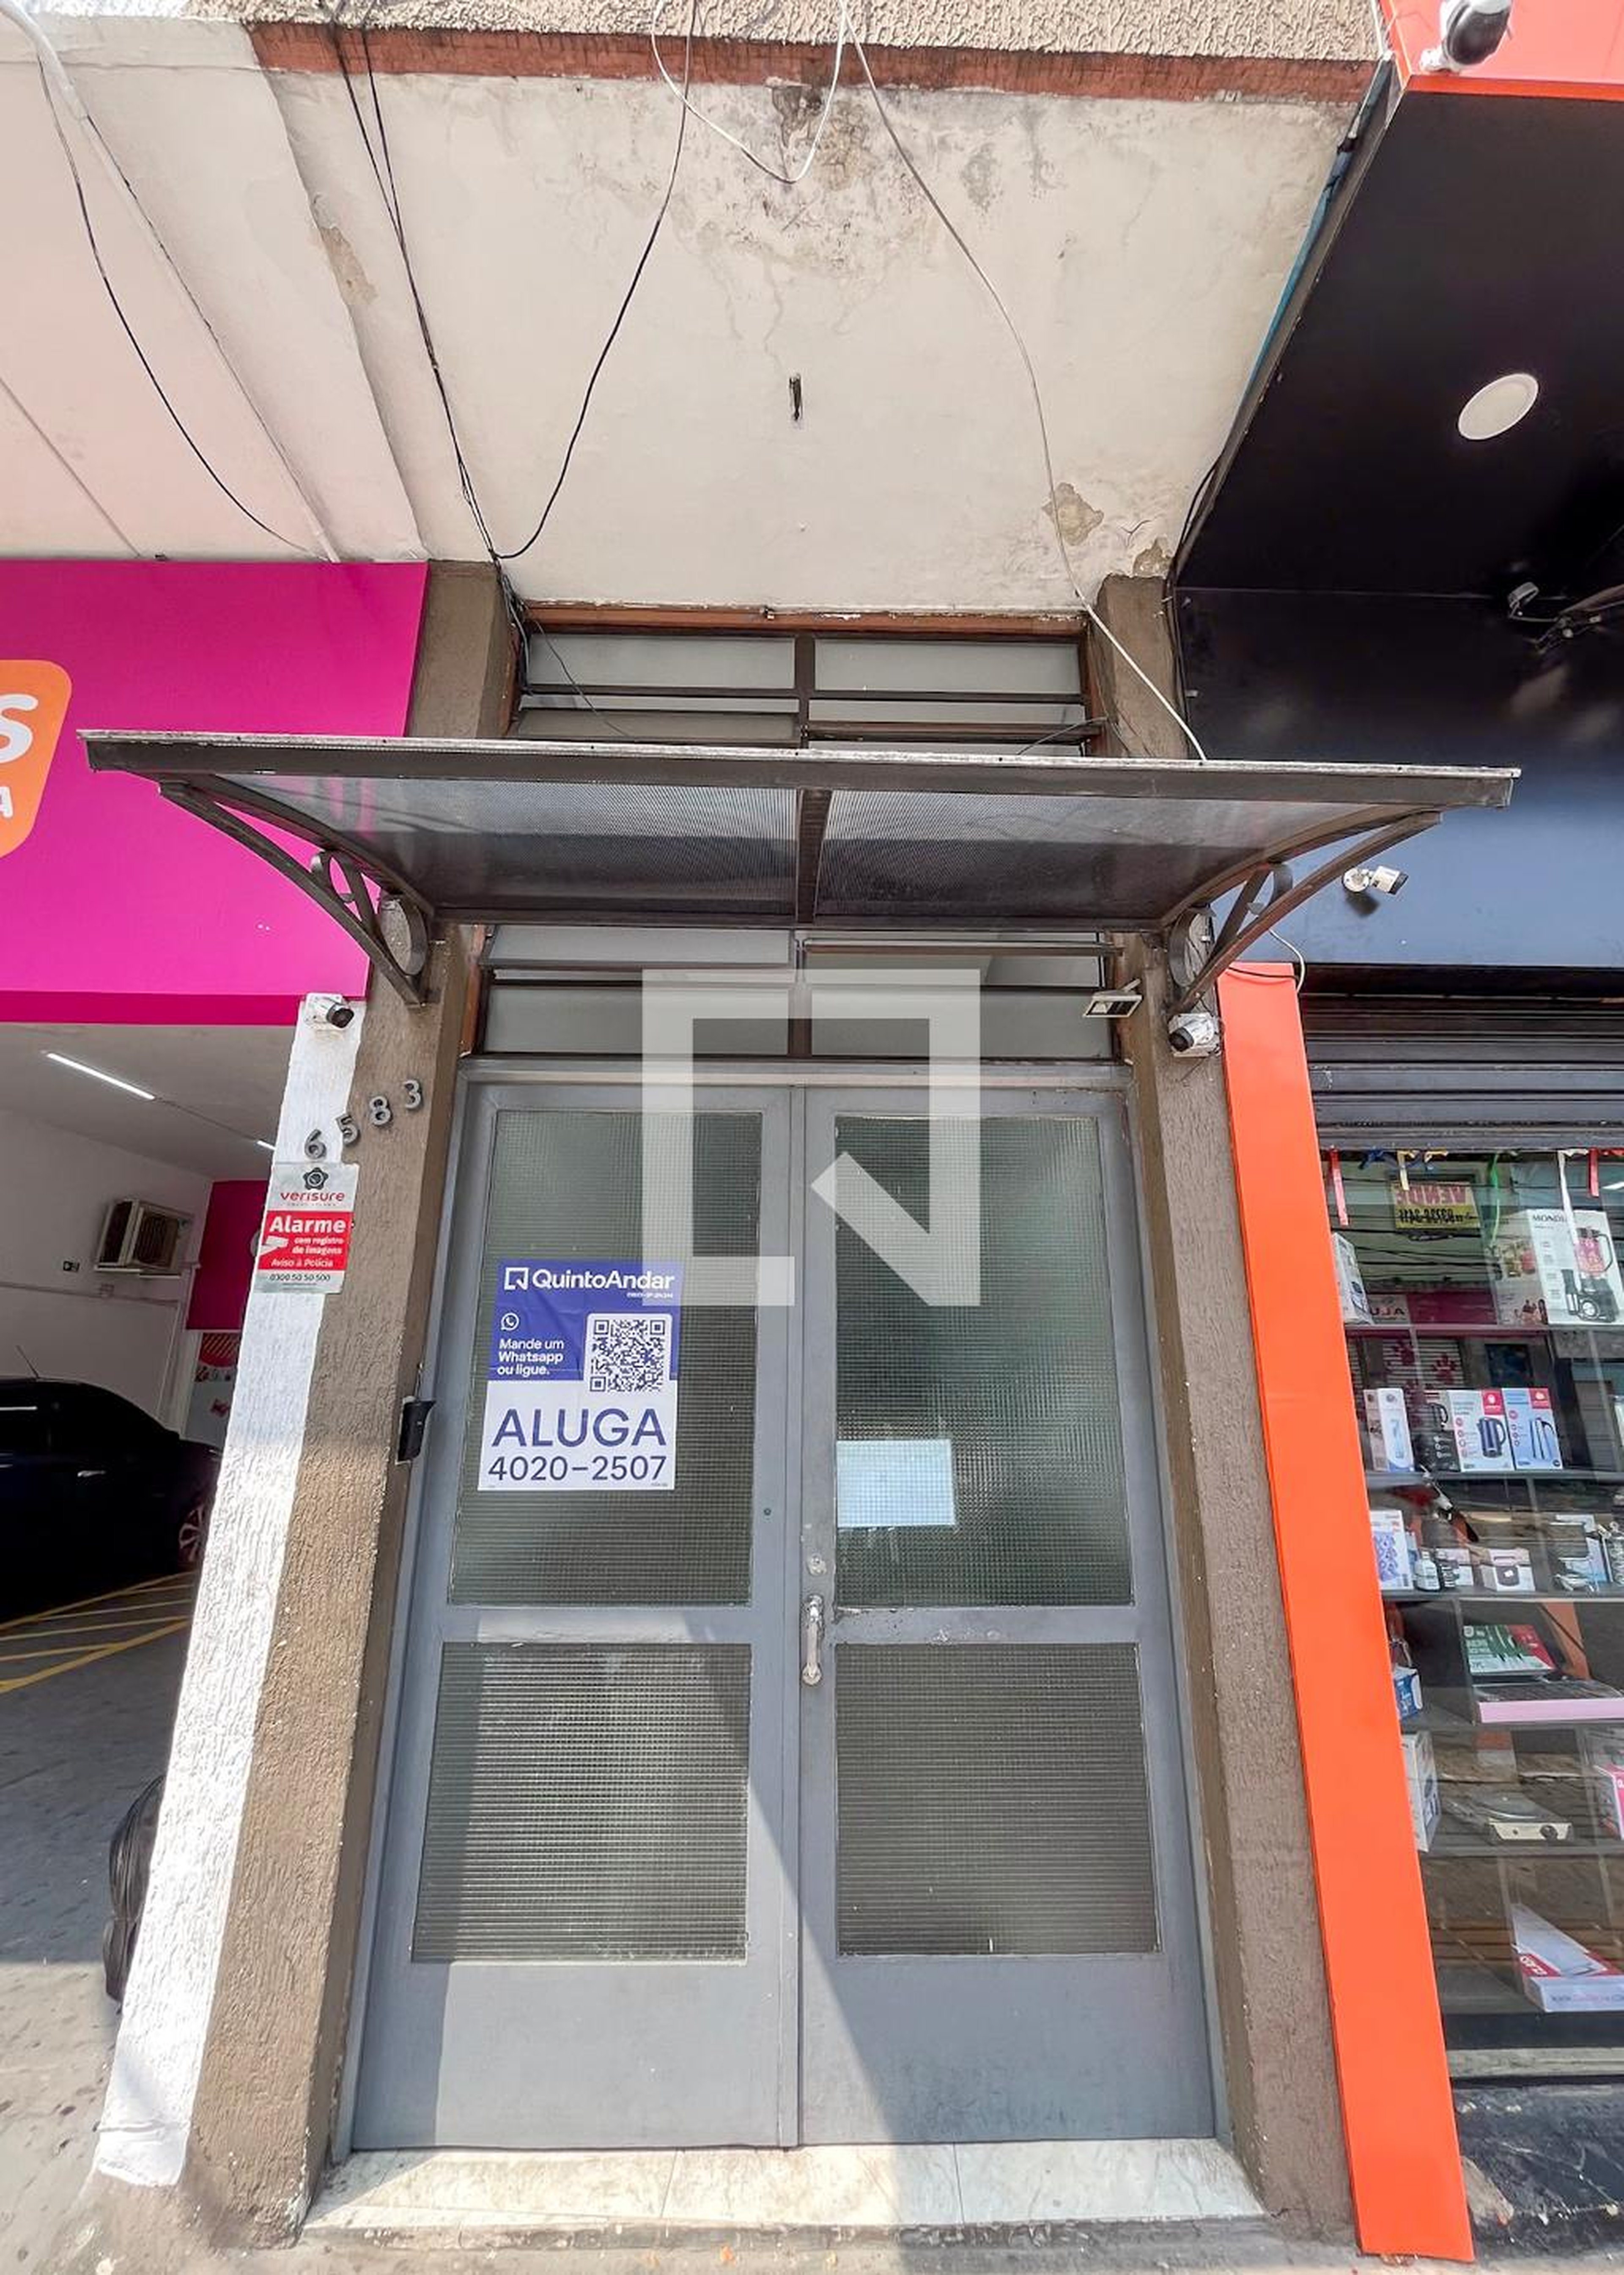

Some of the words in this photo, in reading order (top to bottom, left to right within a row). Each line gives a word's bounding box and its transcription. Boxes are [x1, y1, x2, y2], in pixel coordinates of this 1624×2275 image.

[280, 1192, 345, 1201] verisure
[269, 1214, 346, 1233] Alarme
[292, 1246, 304, 1254] de
[305, 1246, 342, 1256] imagens
[271, 1258, 295, 1267] Aviso
[532, 1269, 675, 1289] QuintoAndar
[499, 1338, 541, 1350] Mande
[544, 1341, 564, 1350] um
[499, 1352, 564, 1365] Whatsapp
[514, 1364, 550, 1377] ligue.
[491, 1408, 667, 1448] ALUGA
[488, 1455, 667, 1481] 4020-2507
